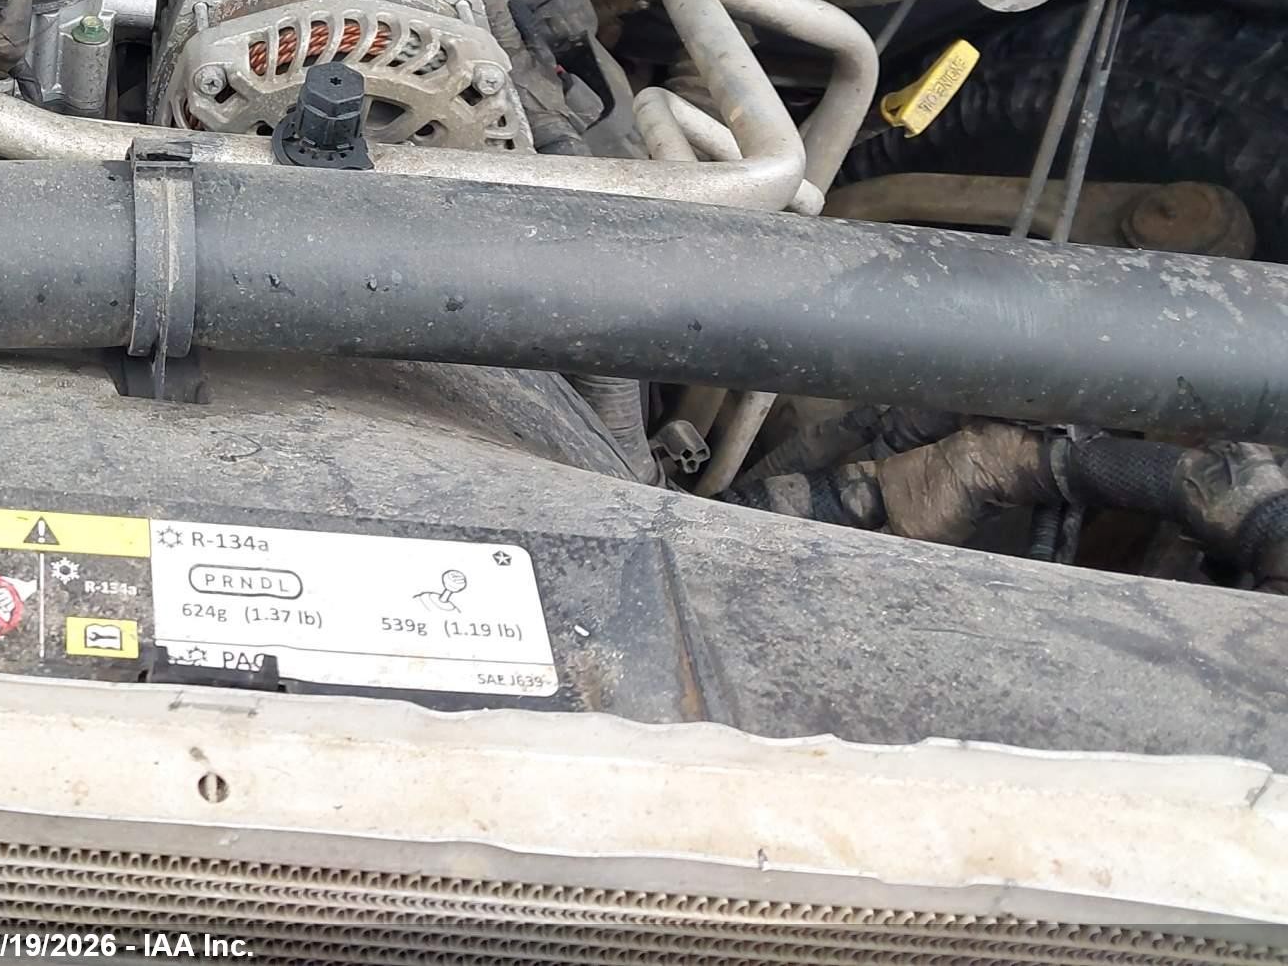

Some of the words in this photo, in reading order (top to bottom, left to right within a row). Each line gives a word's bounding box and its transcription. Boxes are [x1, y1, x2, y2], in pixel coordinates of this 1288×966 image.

[932, 55, 967, 97] ENGINE
[192, 531, 269, 552] R-134a
[84, 580, 138, 596] R-134a
[182, 603, 228, 623] 624g
[244, 605, 291, 624] (1.37
[298, 610, 323, 629] lb)
[381, 617, 428, 636] 539g
[444, 620, 491, 638] (1.19
[498, 623, 523, 641] lb)
[477, 673, 505, 686] SAE
